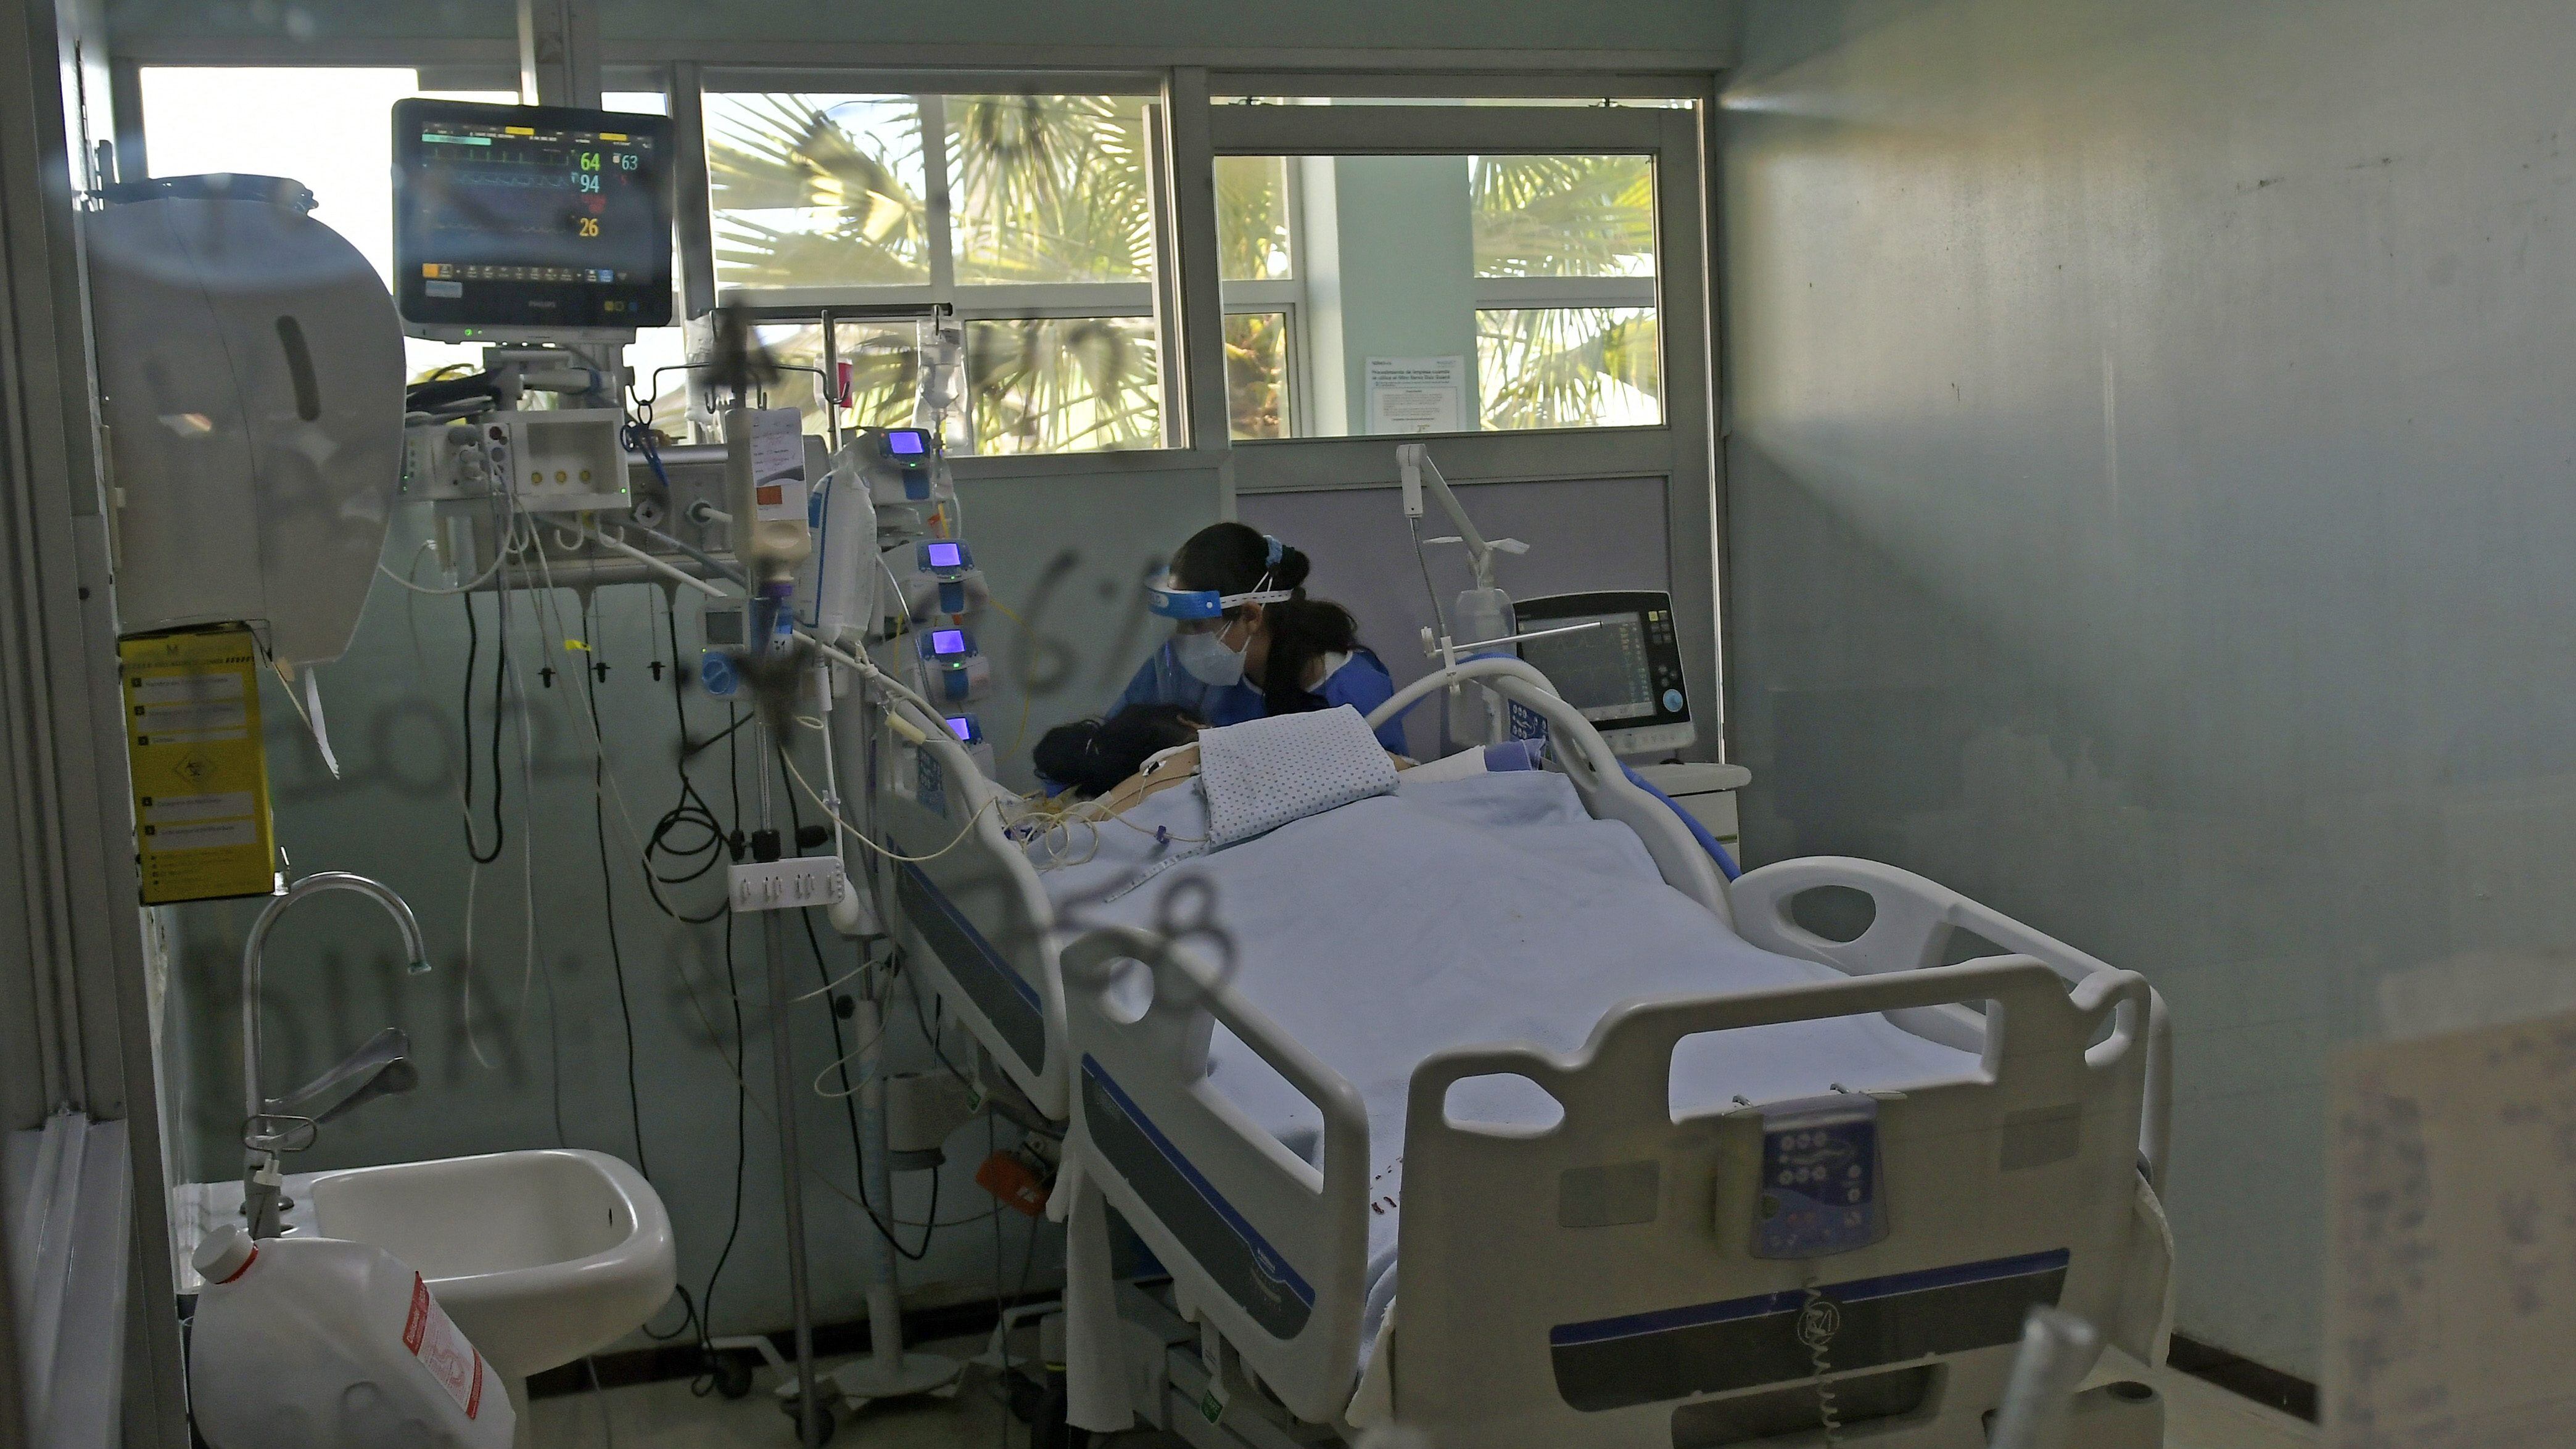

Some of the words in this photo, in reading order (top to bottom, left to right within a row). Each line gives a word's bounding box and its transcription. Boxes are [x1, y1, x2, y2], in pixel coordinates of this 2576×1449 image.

[580, 152, 600, 171] 64
[622, 155, 638, 170] 63
[580, 175, 600, 192] 94
[579, 218, 599, 236] 26
